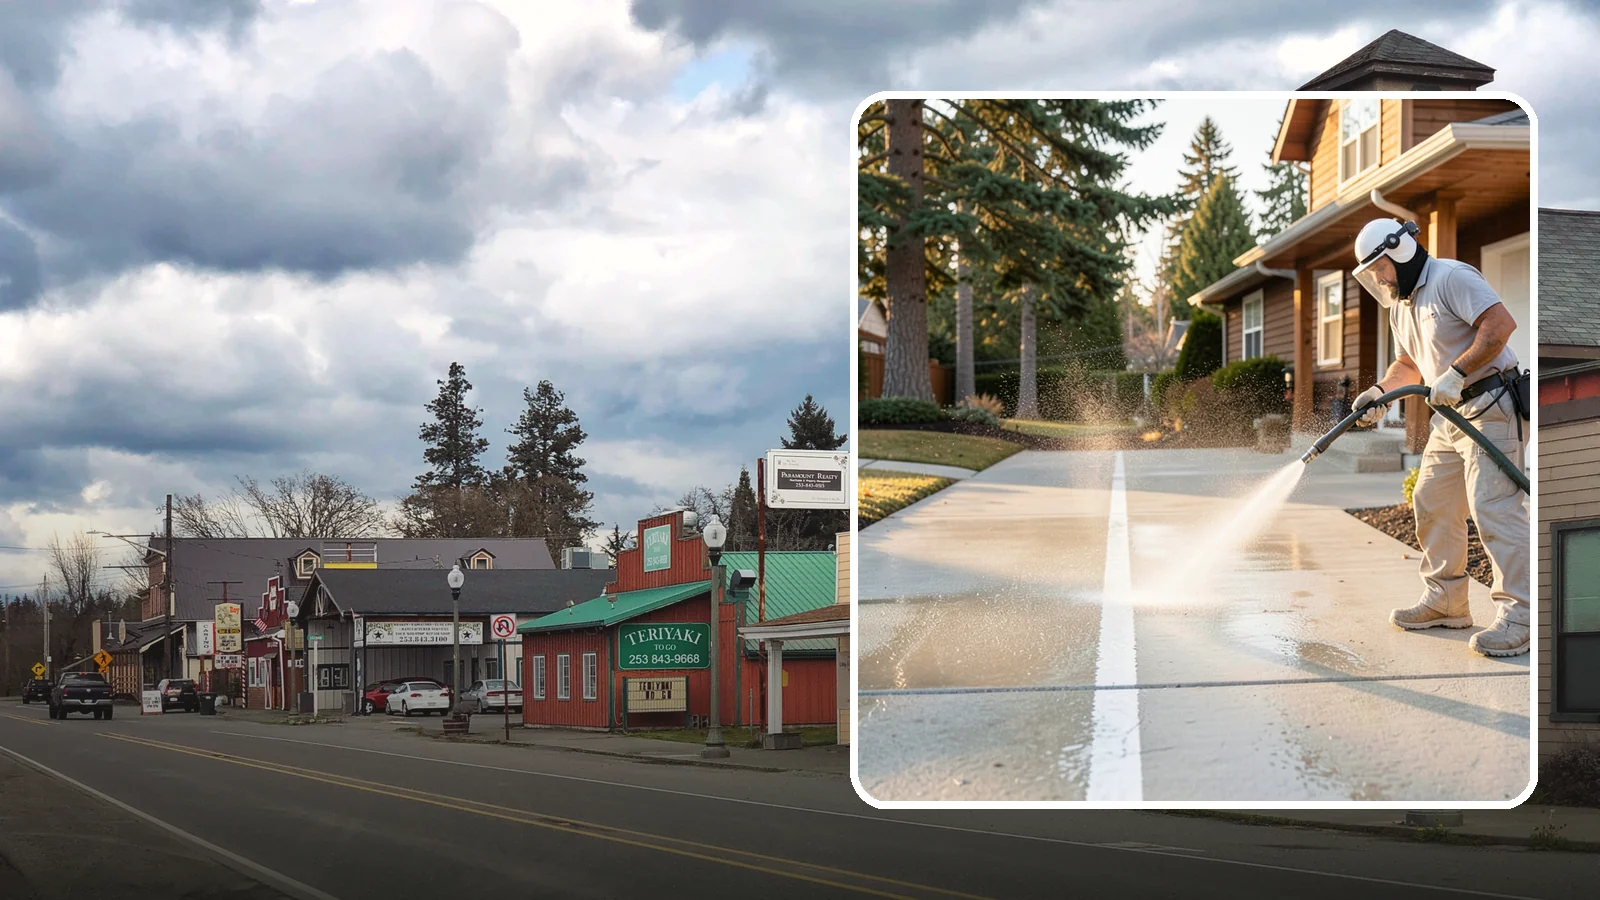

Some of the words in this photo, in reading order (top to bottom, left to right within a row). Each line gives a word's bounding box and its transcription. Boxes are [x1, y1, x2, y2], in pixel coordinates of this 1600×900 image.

[781, 471, 814, 479] PARAMOUNT
[817, 472, 839, 480] REALTY
[624, 627, 702, 646] TERIYAKI
[629, 654, 648, 664] 253
[652, 654, 700, 664] 843-9668
[639, 681, 672, 691] TERIYAKI
